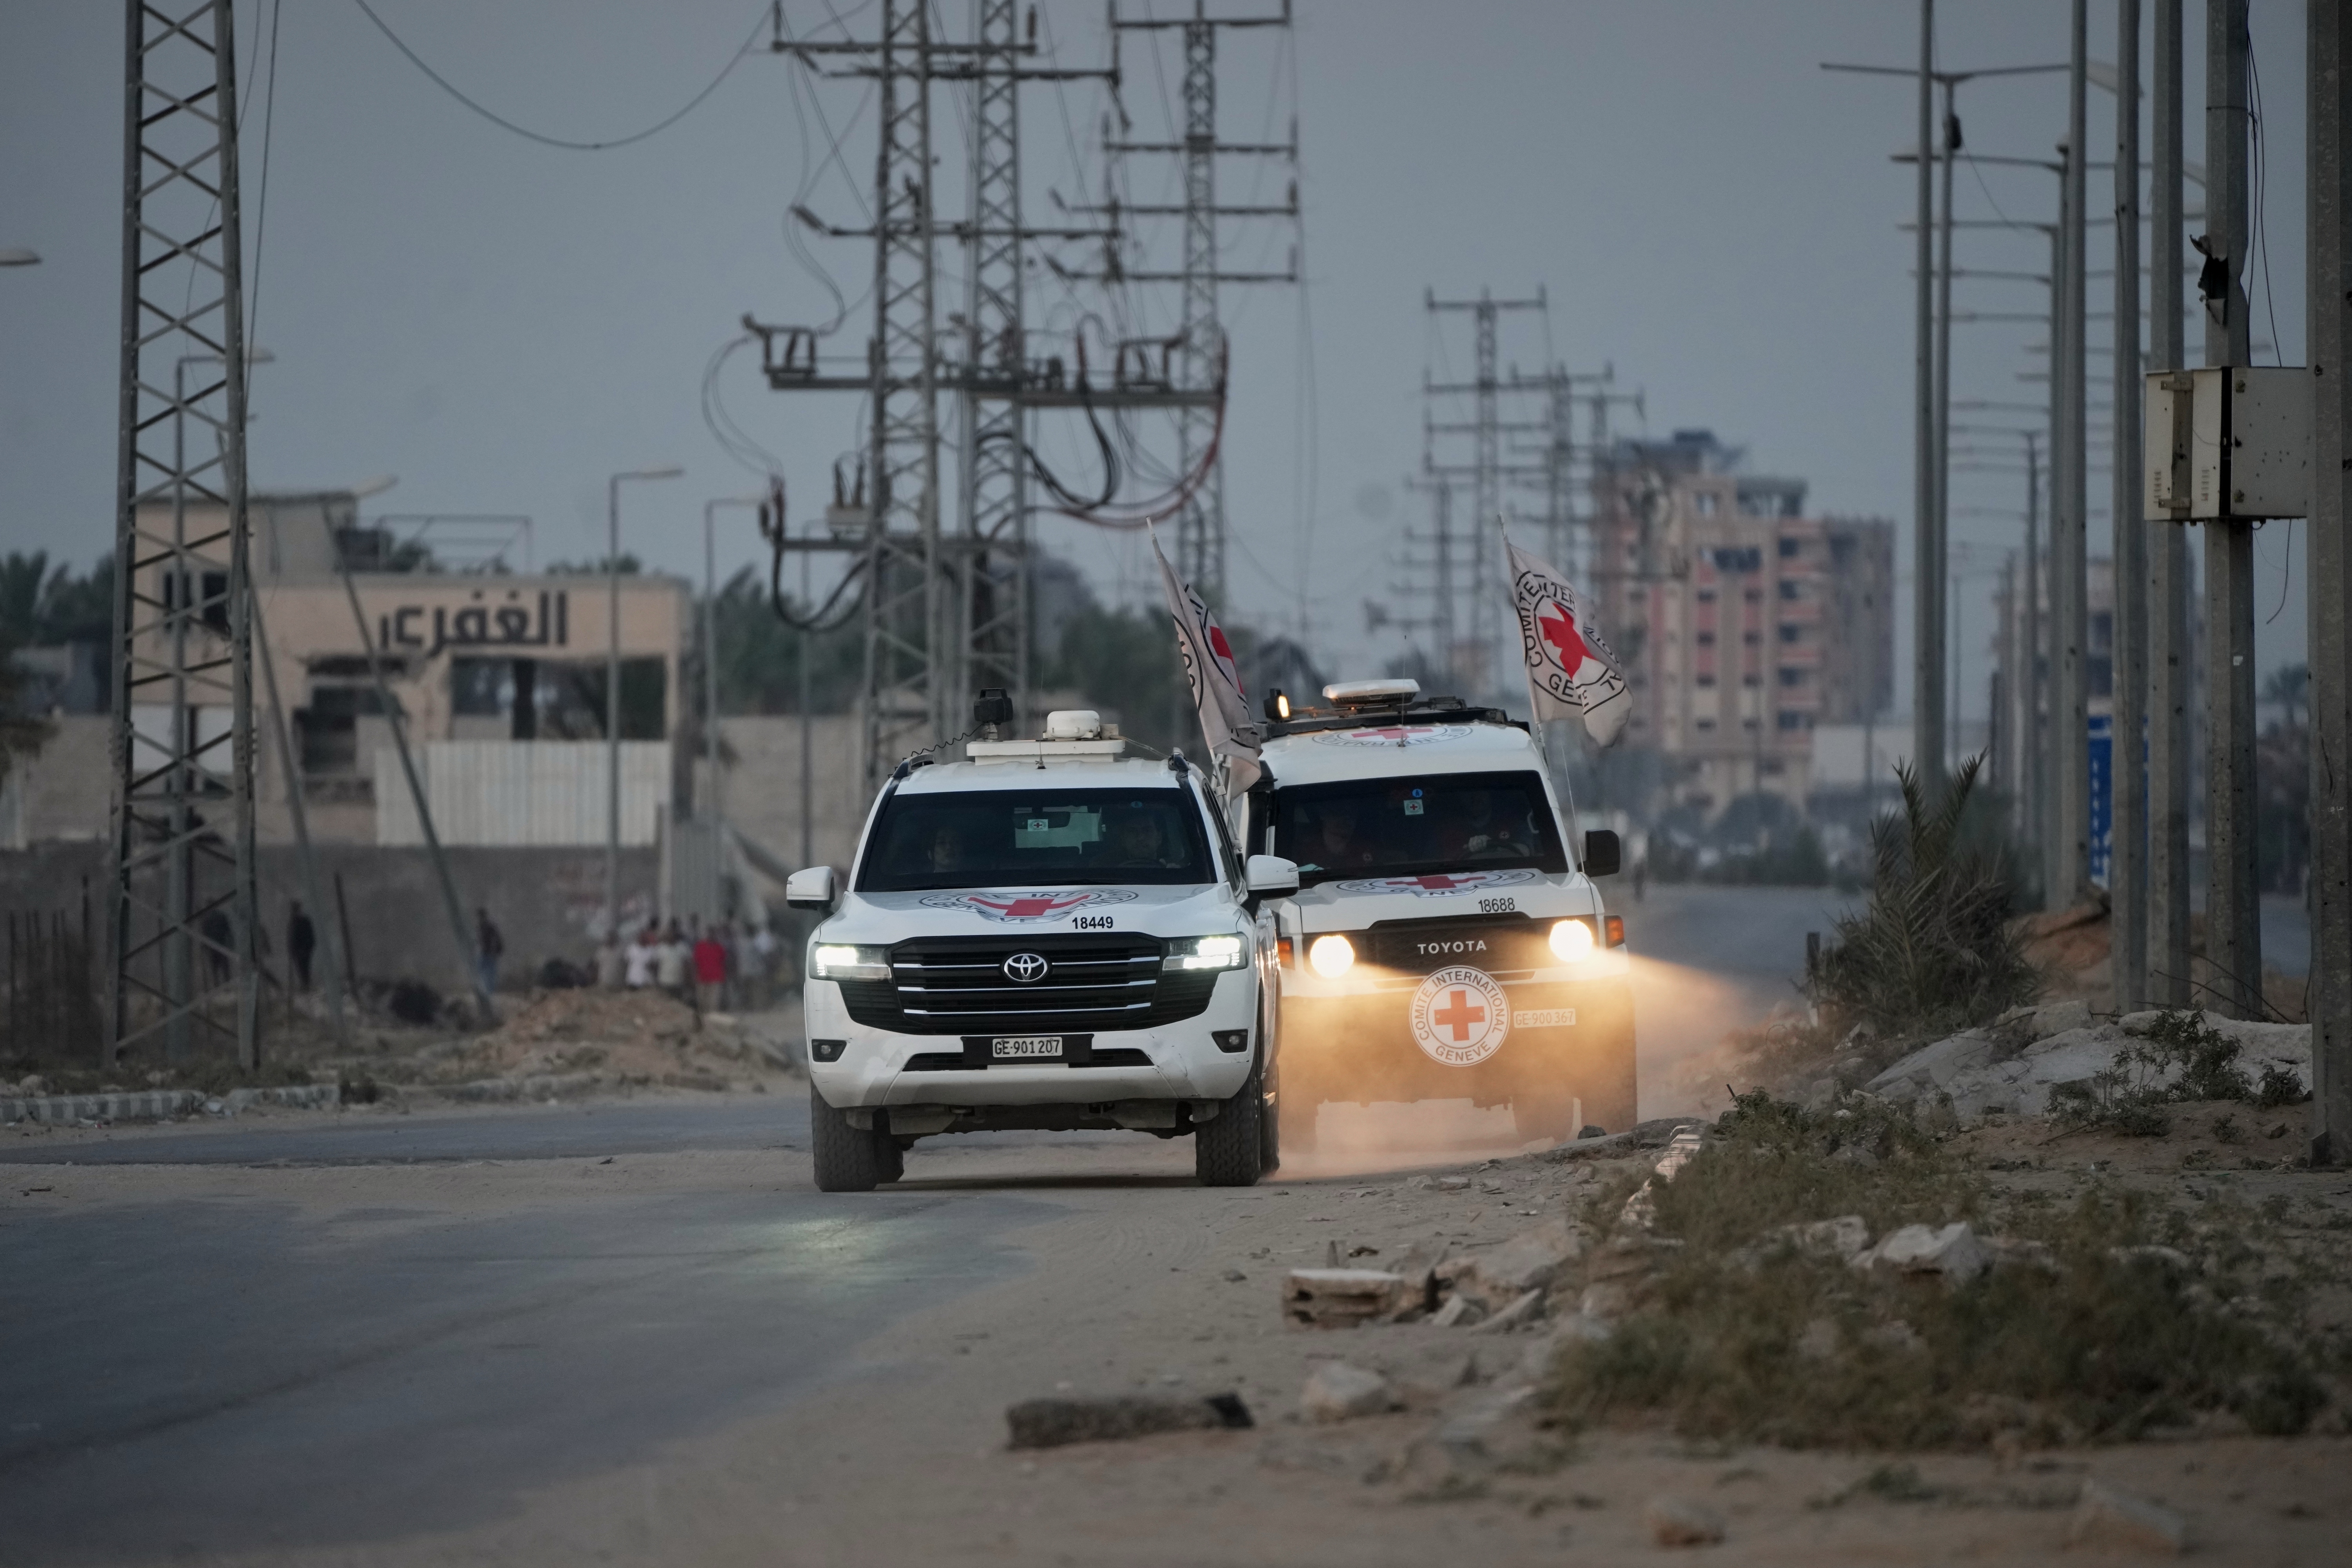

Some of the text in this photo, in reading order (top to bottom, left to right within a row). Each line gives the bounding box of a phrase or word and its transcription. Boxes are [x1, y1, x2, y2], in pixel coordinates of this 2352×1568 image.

[1390, 884, 1499, 896] GNEVE
[1478, 897, 1515, 912] 18688
[1072, 916, 1114, 929] 18449
[1417, 940, 1487, 955] TOYOTA
[1415, 971, 1505, 1040] COMITE INTERNATIONAL
[1435, 1041, 1491, 1062] GENEVE
